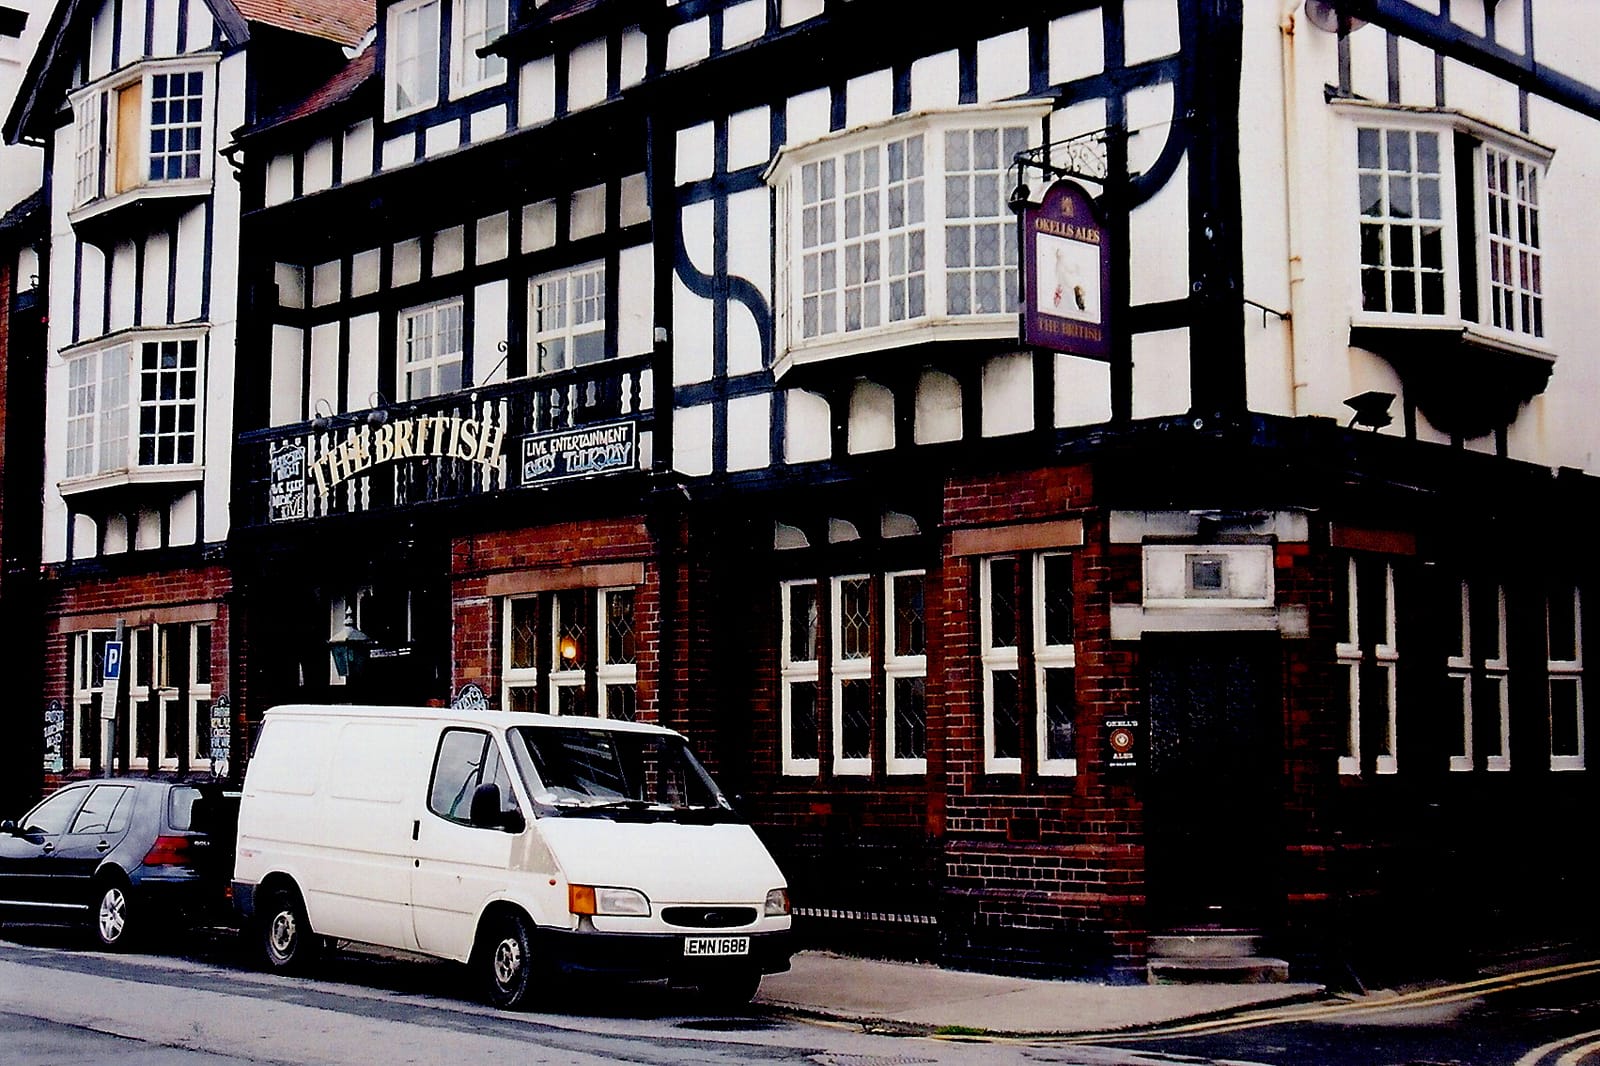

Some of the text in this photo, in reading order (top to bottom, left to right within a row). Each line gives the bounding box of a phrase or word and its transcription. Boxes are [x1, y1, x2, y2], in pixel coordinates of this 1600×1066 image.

[1035, 217, 1101, 244] OKELLS ALES
[1038, 318, 1102, 341] THE BRITISH
[526, 426, 629, 457] LIVE ENTERTAINMENT
[309, 416, 506, 497] THE BRITISH
[525, 441, 632, 480] EVERY THURSDAY
[108, 648, 118, 673] P
